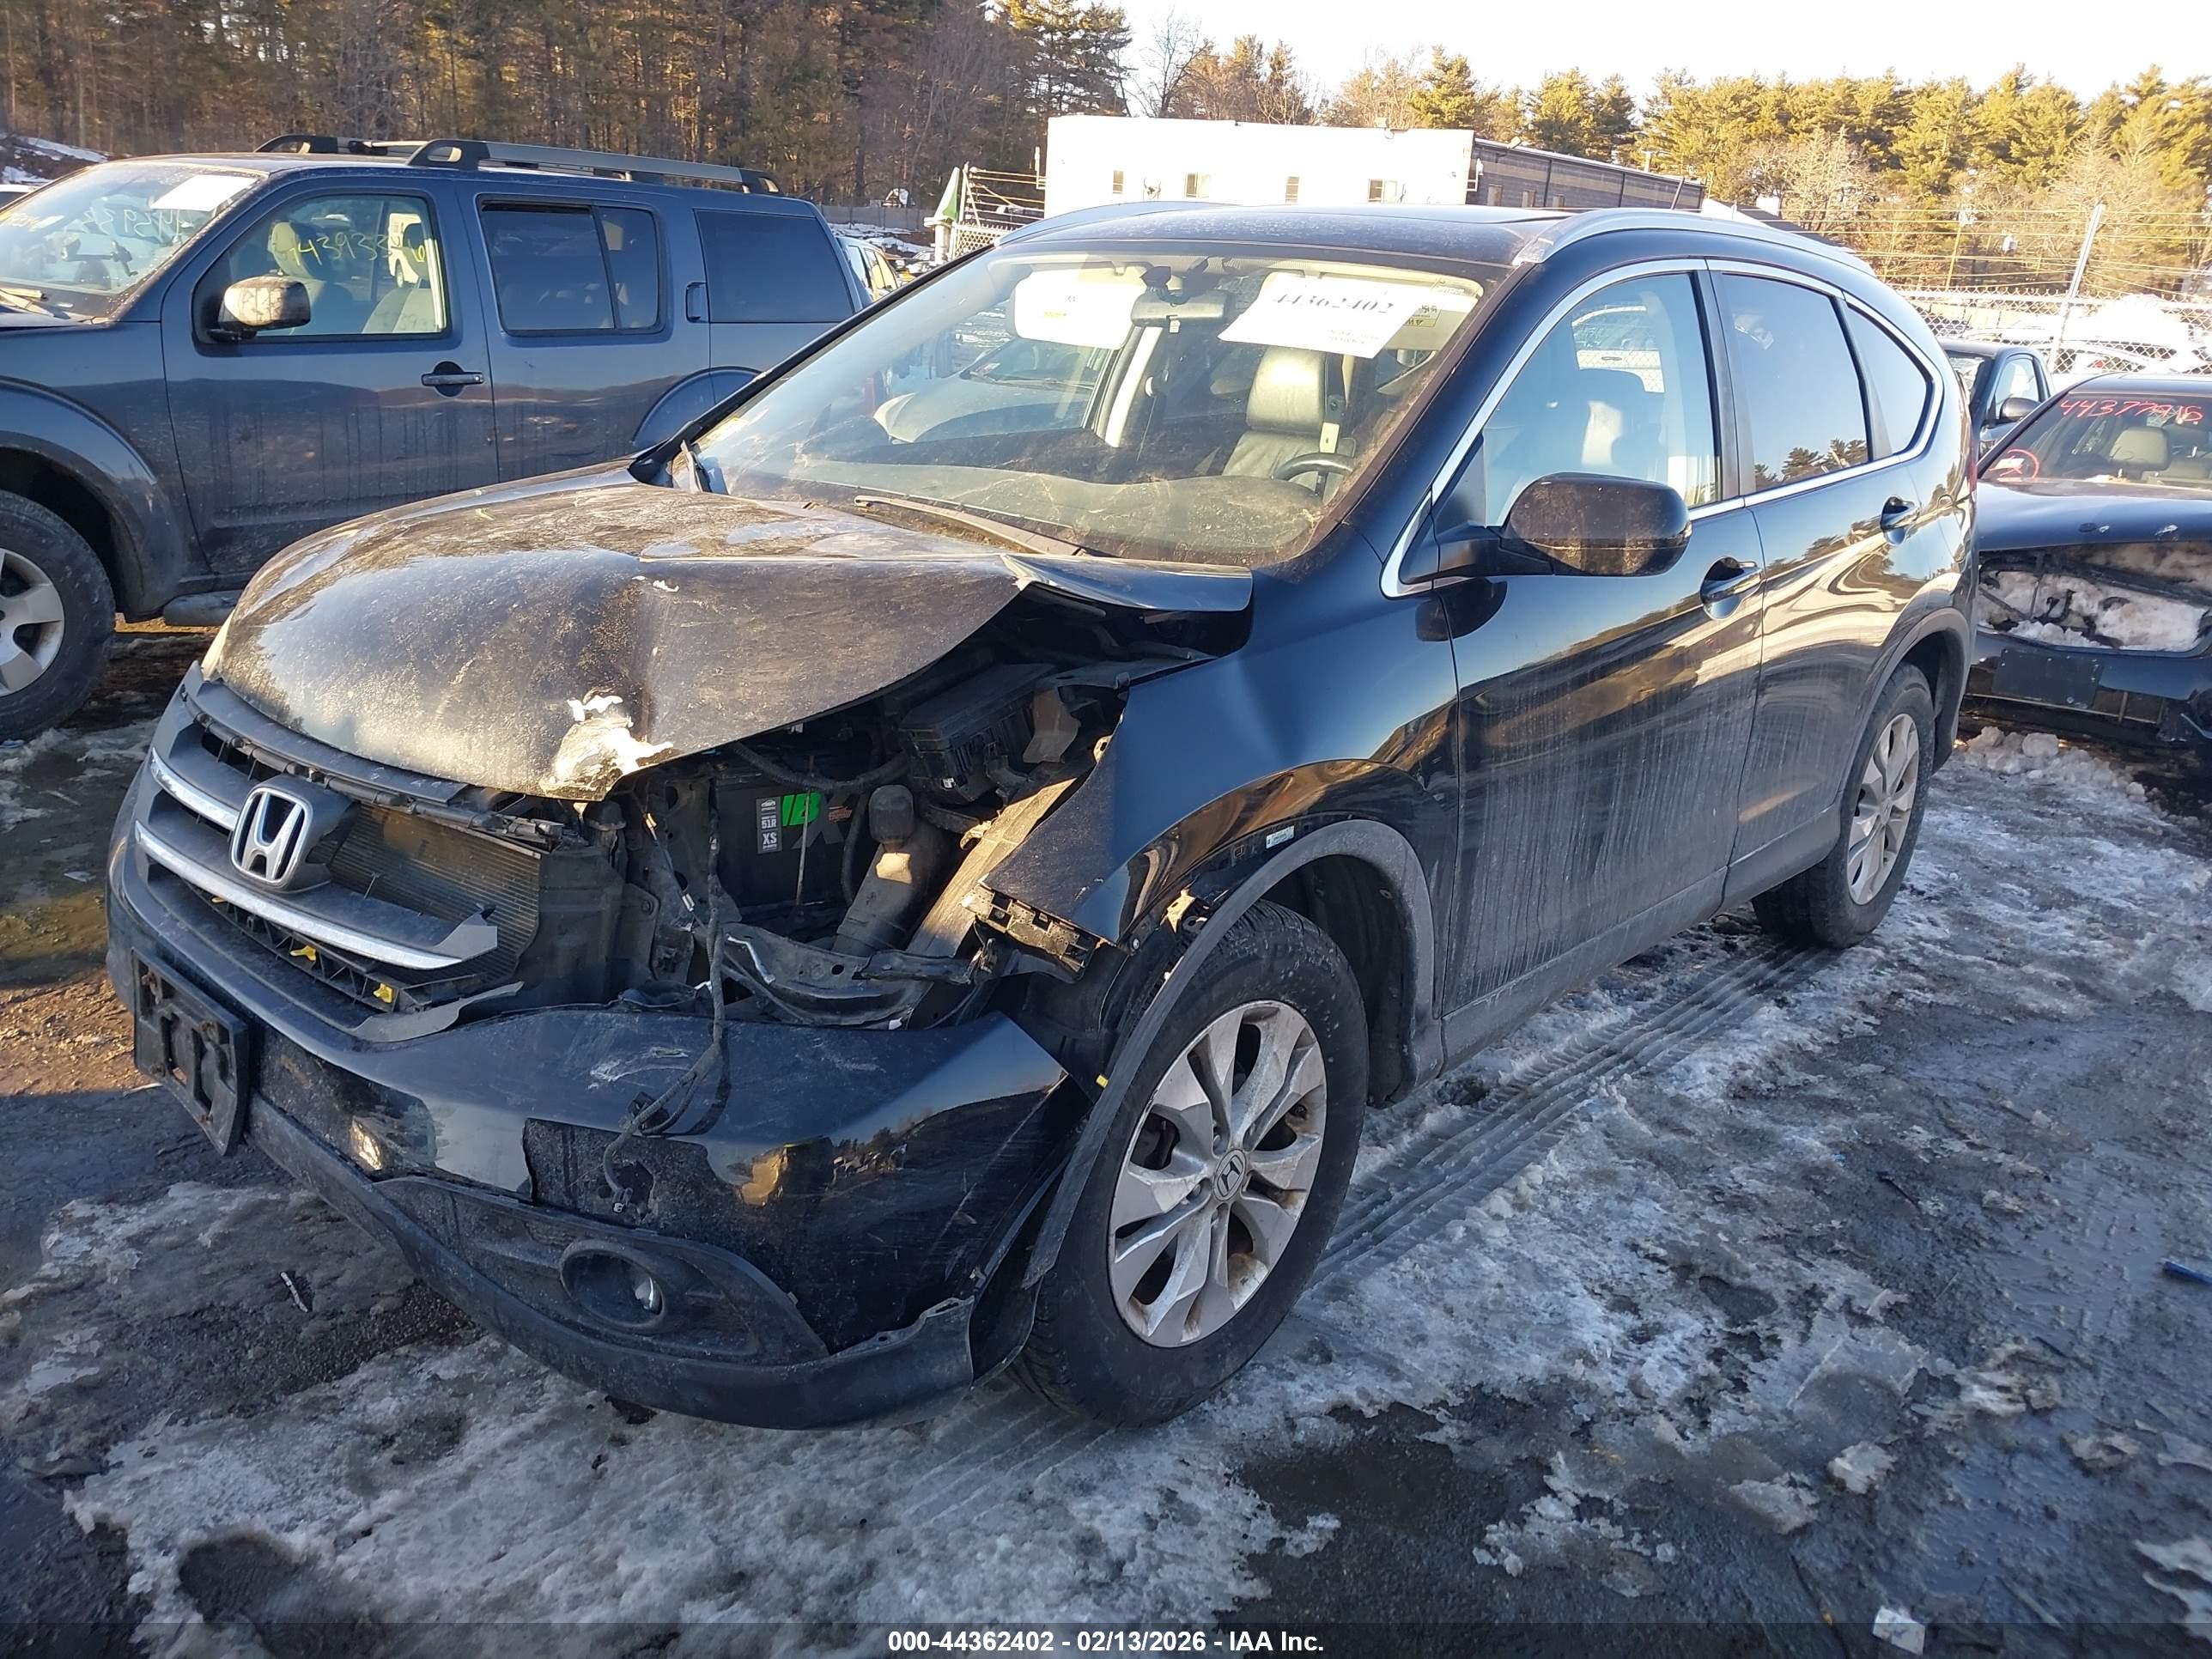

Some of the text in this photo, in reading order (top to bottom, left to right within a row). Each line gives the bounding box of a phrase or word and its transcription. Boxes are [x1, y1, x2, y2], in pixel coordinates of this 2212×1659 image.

[1272, 293, 1395, 314] 44362402
[761, 818, 777, 830] 51R
[762, 832, 778, 844] XS
